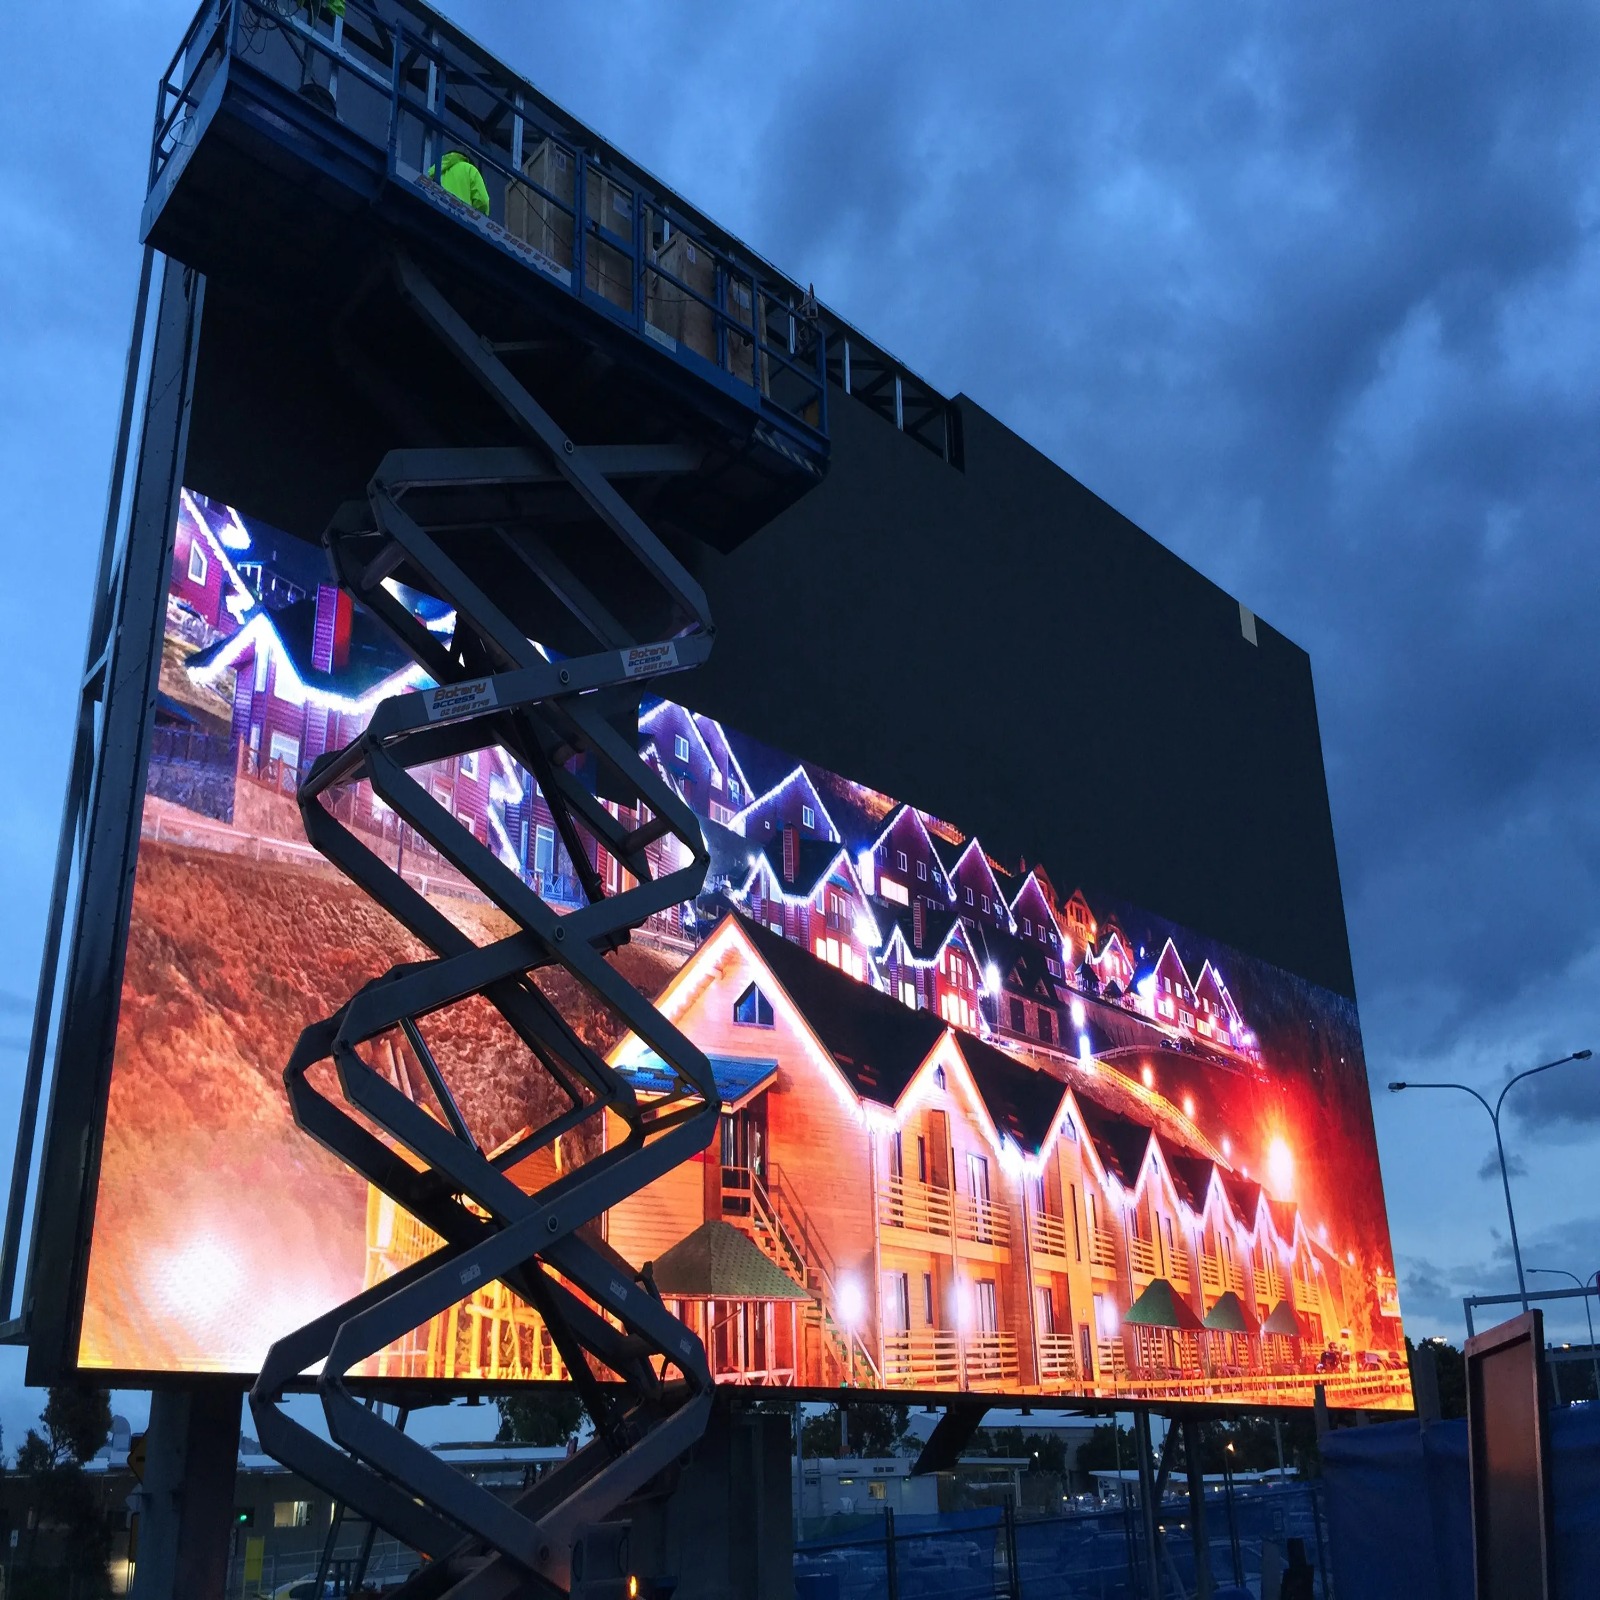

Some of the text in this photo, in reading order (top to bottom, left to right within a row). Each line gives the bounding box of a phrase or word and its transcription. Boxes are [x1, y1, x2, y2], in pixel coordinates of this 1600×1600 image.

[485, 221, 503, 235] 02
[629, 646, 669, 660] Botany
[628, 655, 661, 667] access
[433, 682, 487, 702] Botany
[432, 693, 476, 710] access
